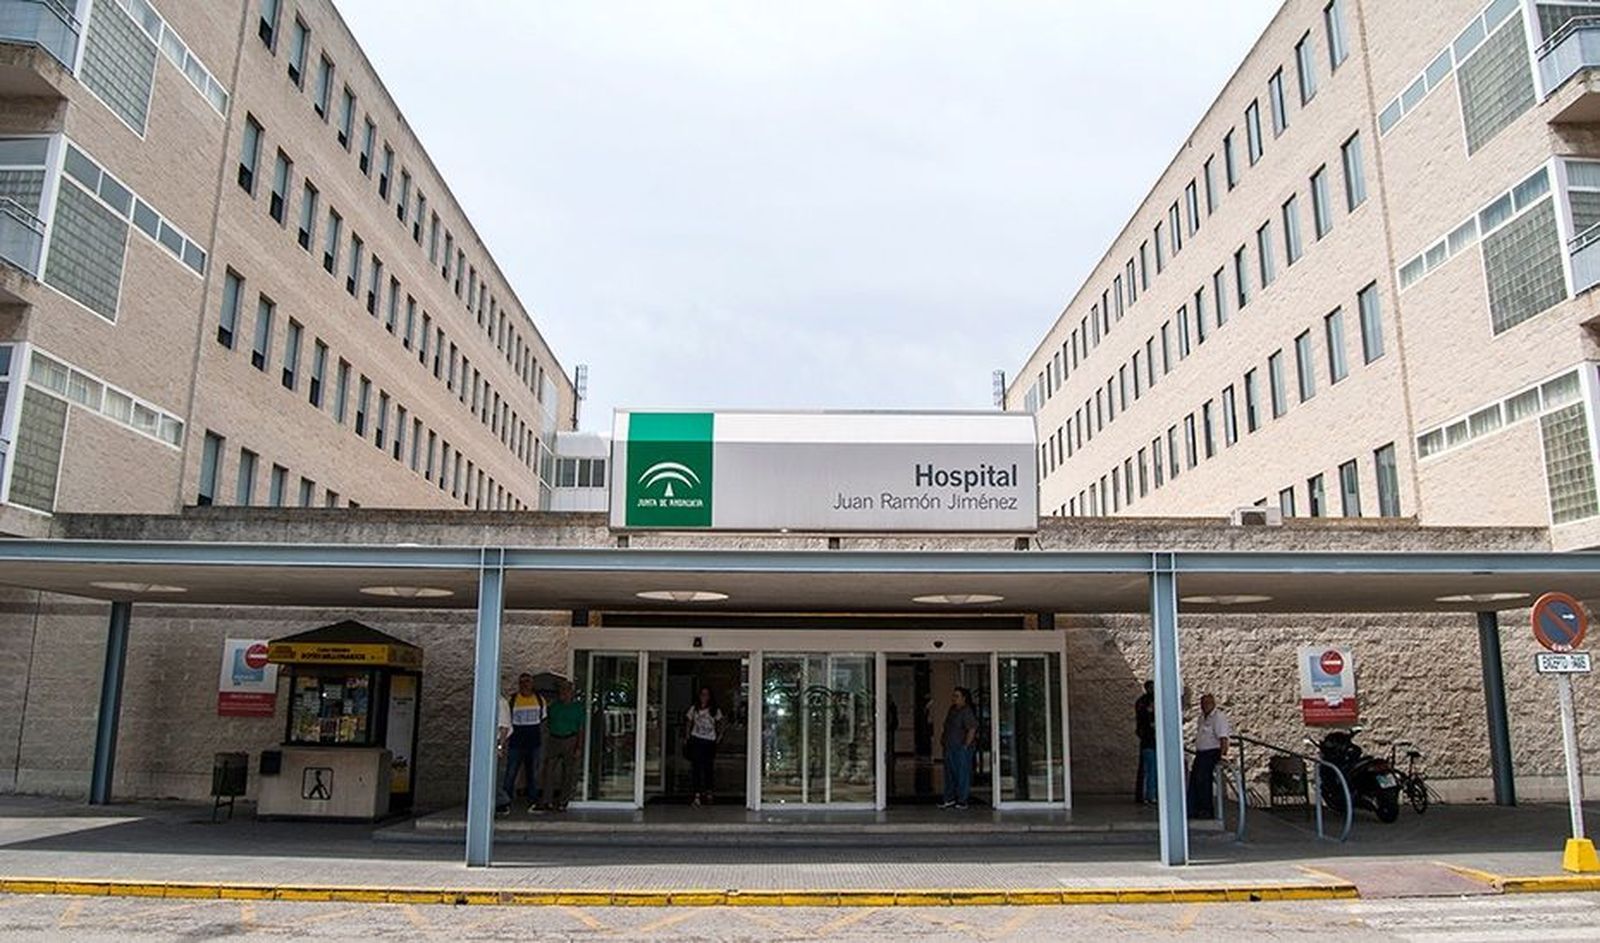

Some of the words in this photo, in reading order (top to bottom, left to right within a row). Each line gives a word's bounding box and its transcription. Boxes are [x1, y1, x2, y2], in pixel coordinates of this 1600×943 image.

[915, 463, 1018, 493] Hospital
[637, 498, 657, 507] JUNTA
[659, 498, 667, 507] DE
[832, 492, 874, 510] Juan
[880, 492, 941, 510] Ramón
[947, 492, 1018, 510] Jiménez
